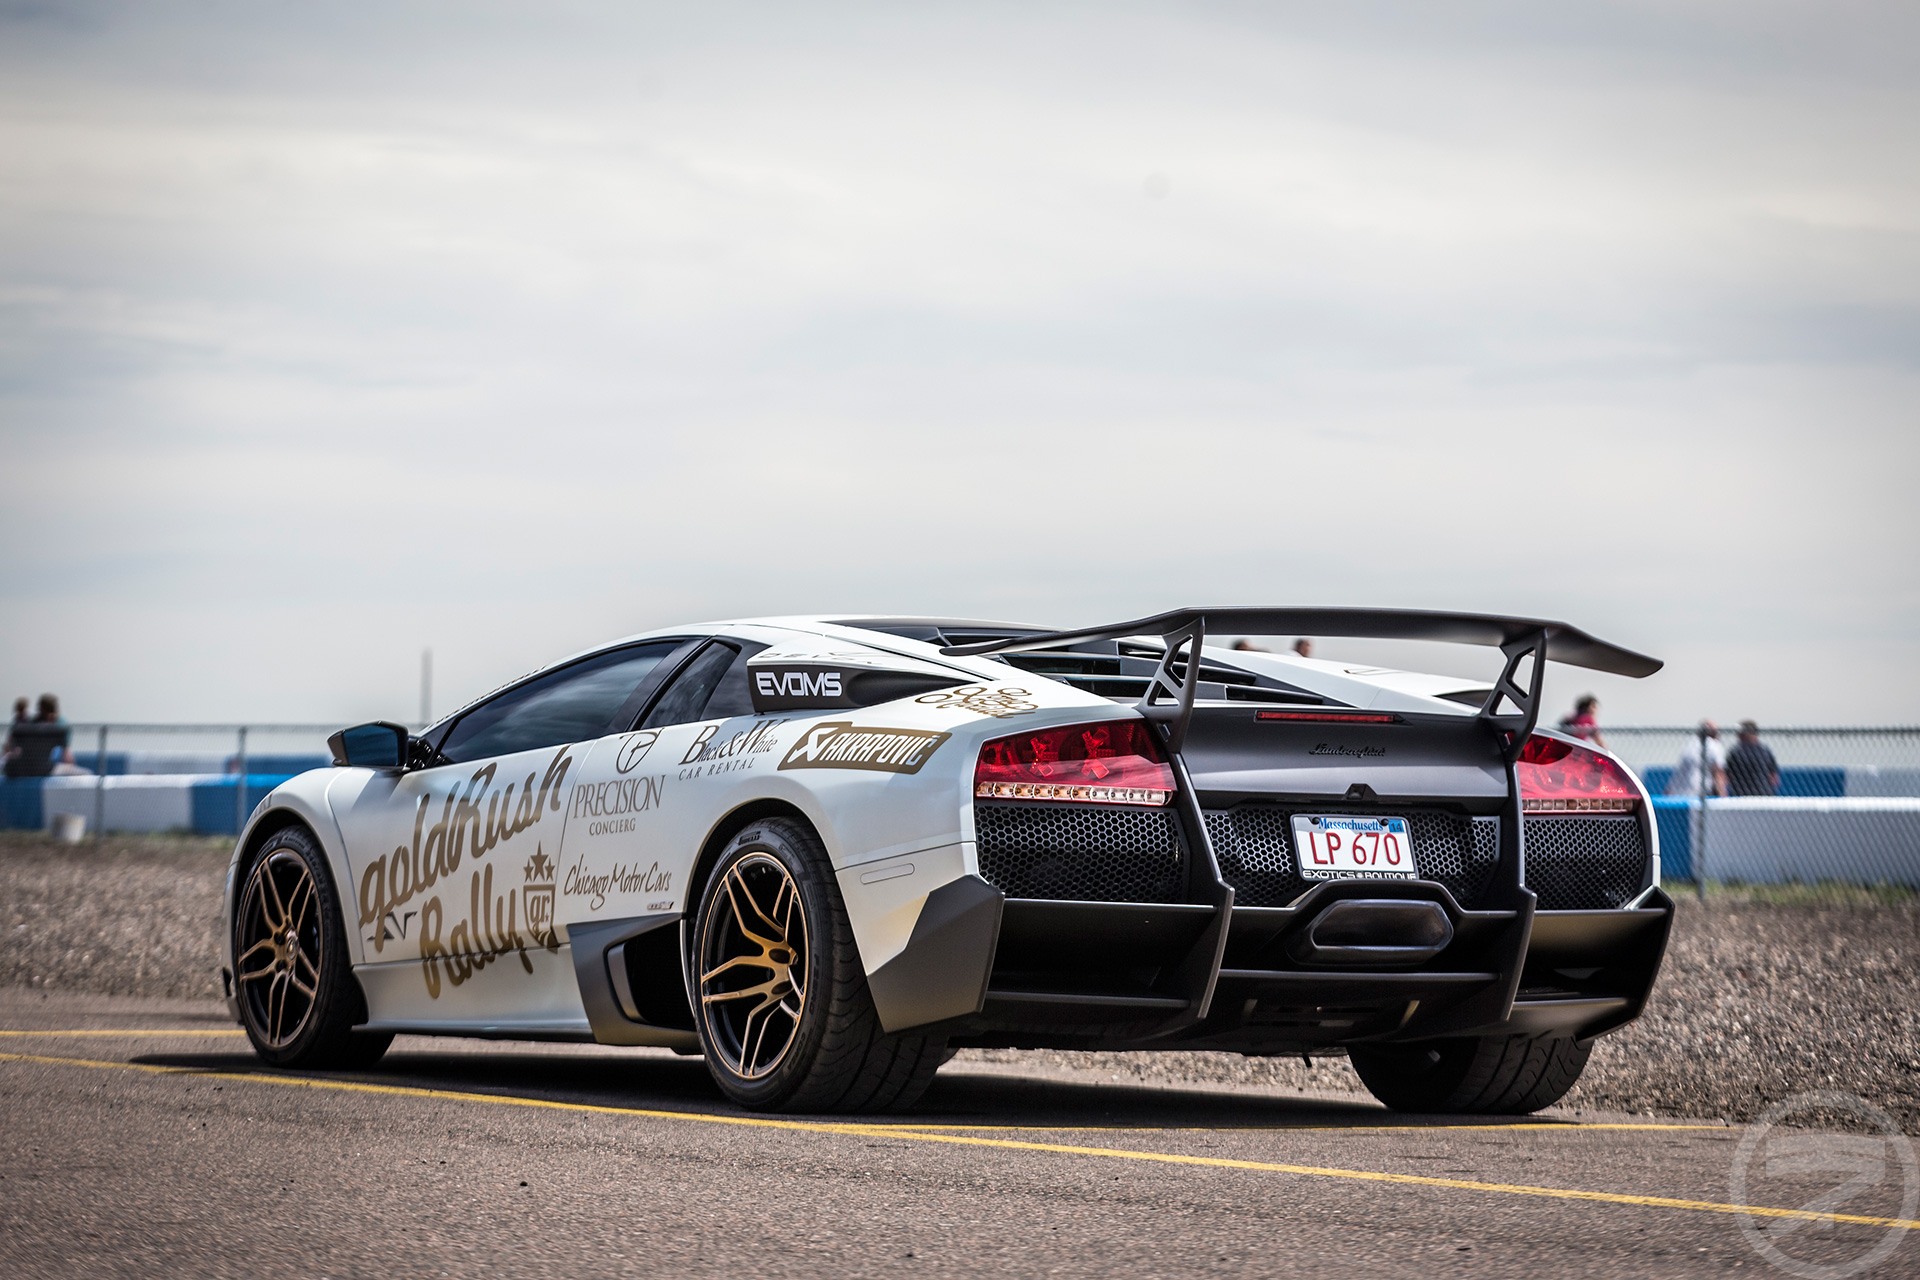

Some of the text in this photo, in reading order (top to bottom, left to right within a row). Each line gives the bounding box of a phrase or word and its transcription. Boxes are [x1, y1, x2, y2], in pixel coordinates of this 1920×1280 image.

[755, 671, 843, 697] EVOMS
[678, 757, 756, 781] CAR RENTAL
[573, 774, 666, 819] PRECISION
[589, 817, 637, 837] CONCIERG
[1318, 817, 1384, 832] Massachusetts
[1391, 822, 1403, 833] 14
[1309, 831, 1401, 866] LP 670
[563, 853, 674, 911] Chicago Motor Cars
[1302, 869, 1355, 879] EXOTICS
[419, 863, 534, 999] Rally
